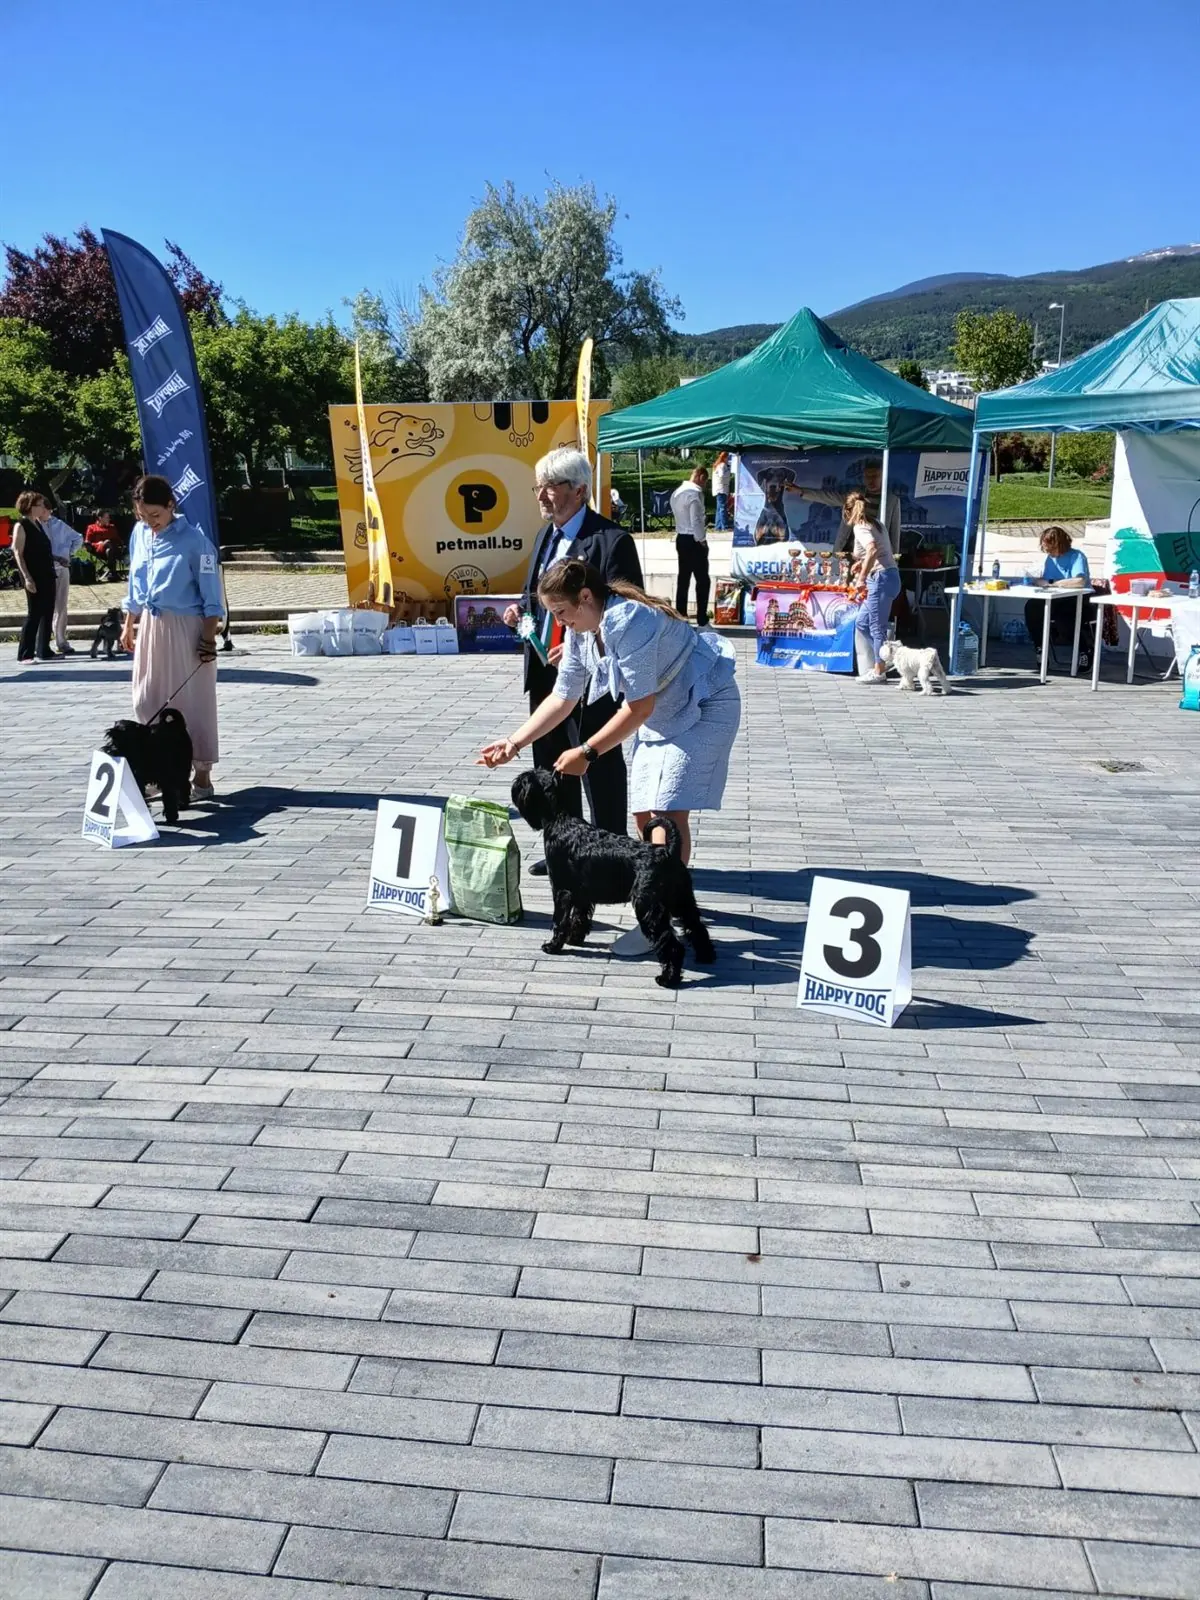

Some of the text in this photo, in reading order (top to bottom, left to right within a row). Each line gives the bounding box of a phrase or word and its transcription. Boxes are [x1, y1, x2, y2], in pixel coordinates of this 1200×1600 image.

[924, 470, 952, 482] HAPPY
[436, 536, 523, 554] petmall.bg
[774, 648, 816, 657] SPECIALTY
[90, 762, 115, 818] 2
[392, 814, 417, 879] 1
[372, 882, 426, 909] HAPPY DOG
[823, 896, 883, 979] 3
[804, 978, 887, 1016] HAPPY DOG
